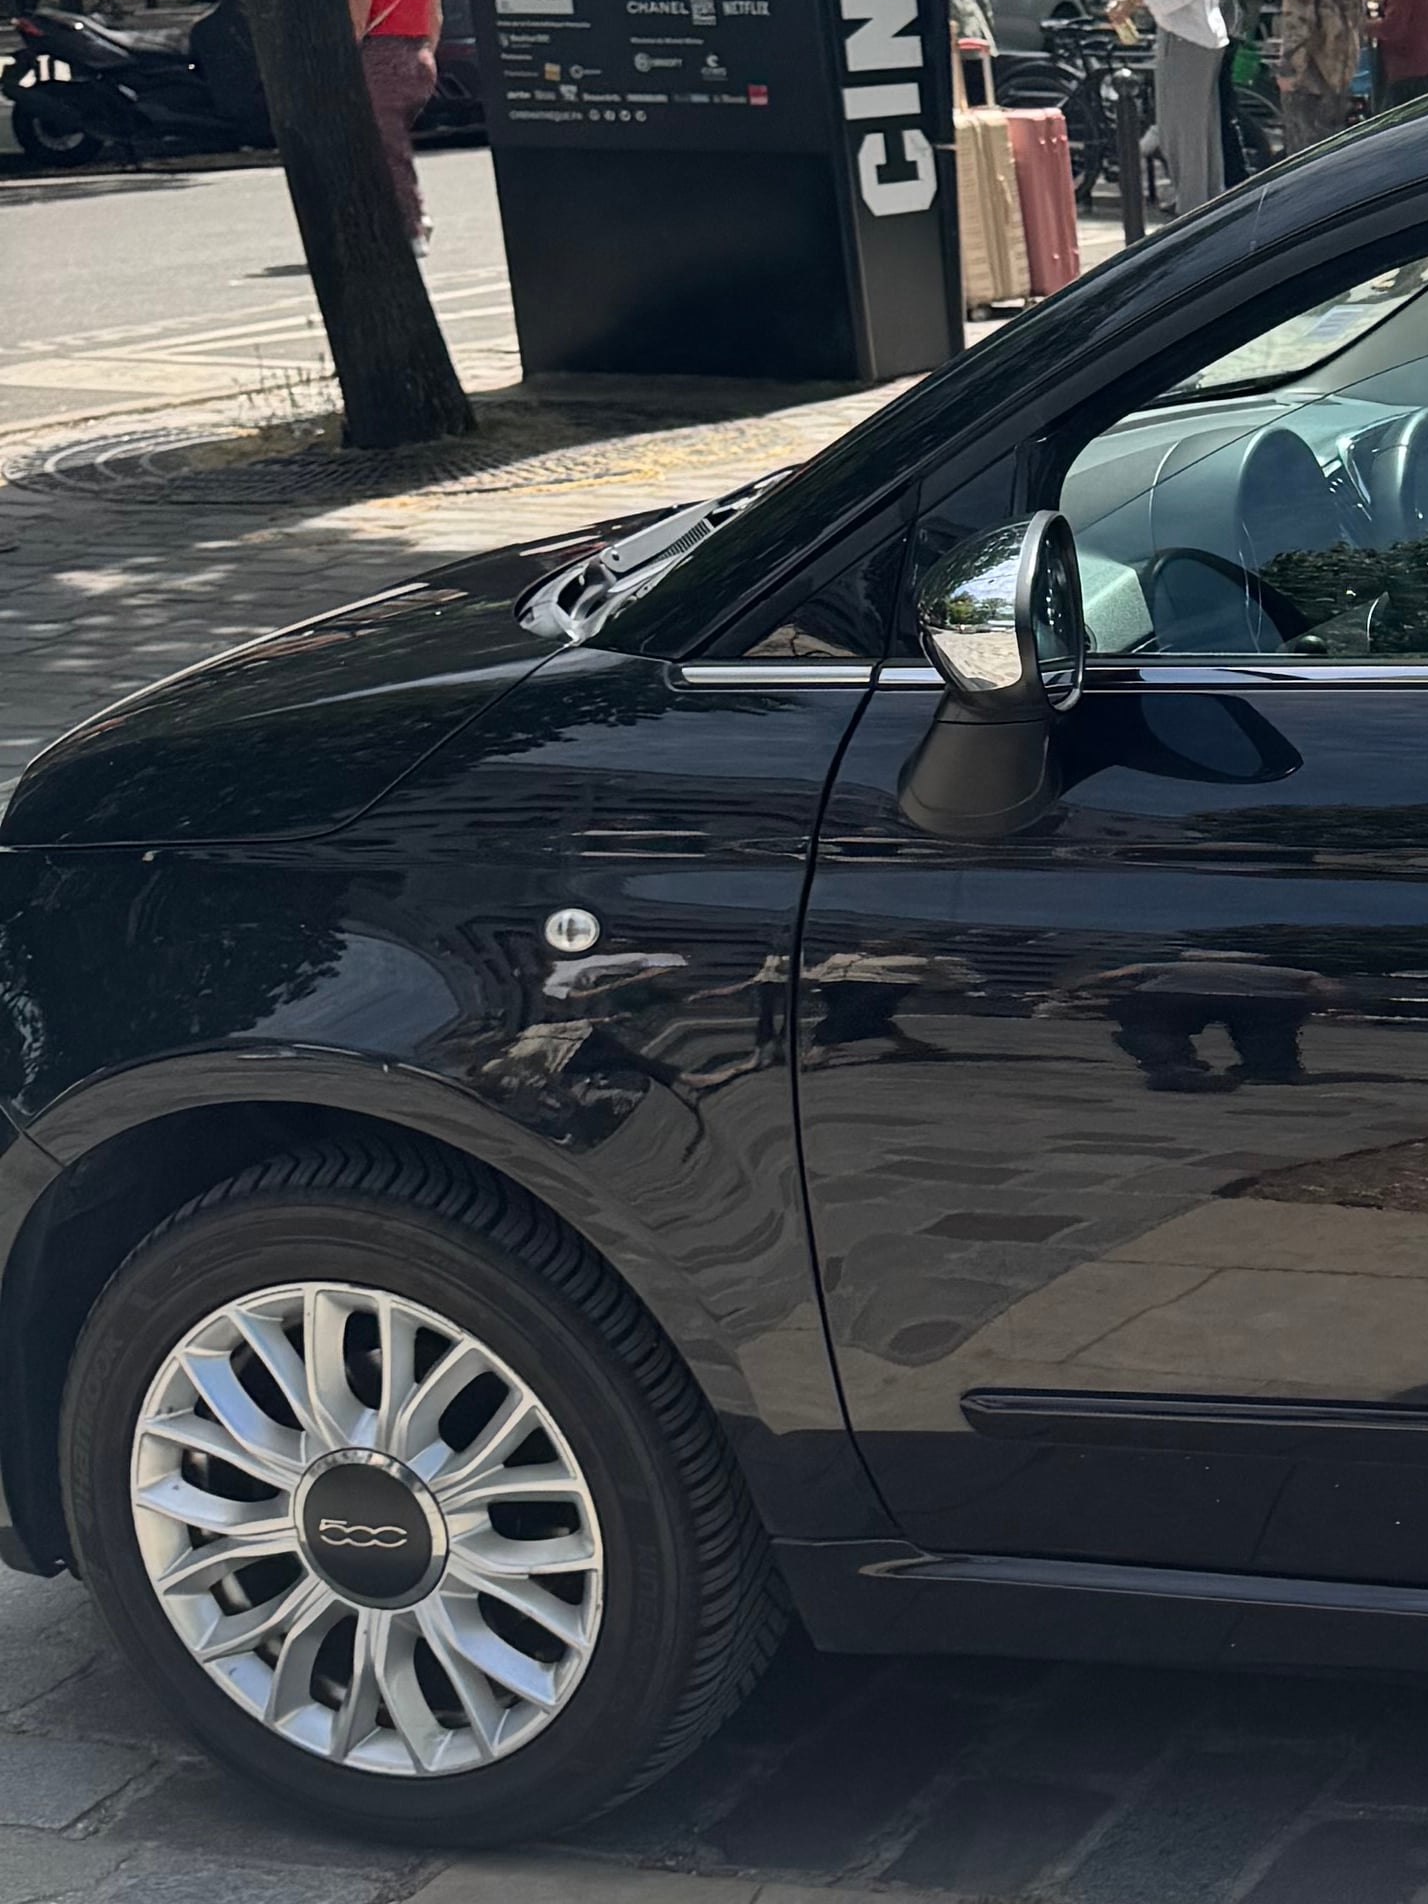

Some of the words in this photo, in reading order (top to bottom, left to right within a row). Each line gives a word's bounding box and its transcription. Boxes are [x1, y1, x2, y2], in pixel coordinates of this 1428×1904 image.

[626, 0, 690, 15] CHANEL
[722, 0, 771, 16] NETFLIX
[318, 1518, 408, 1549] 500
